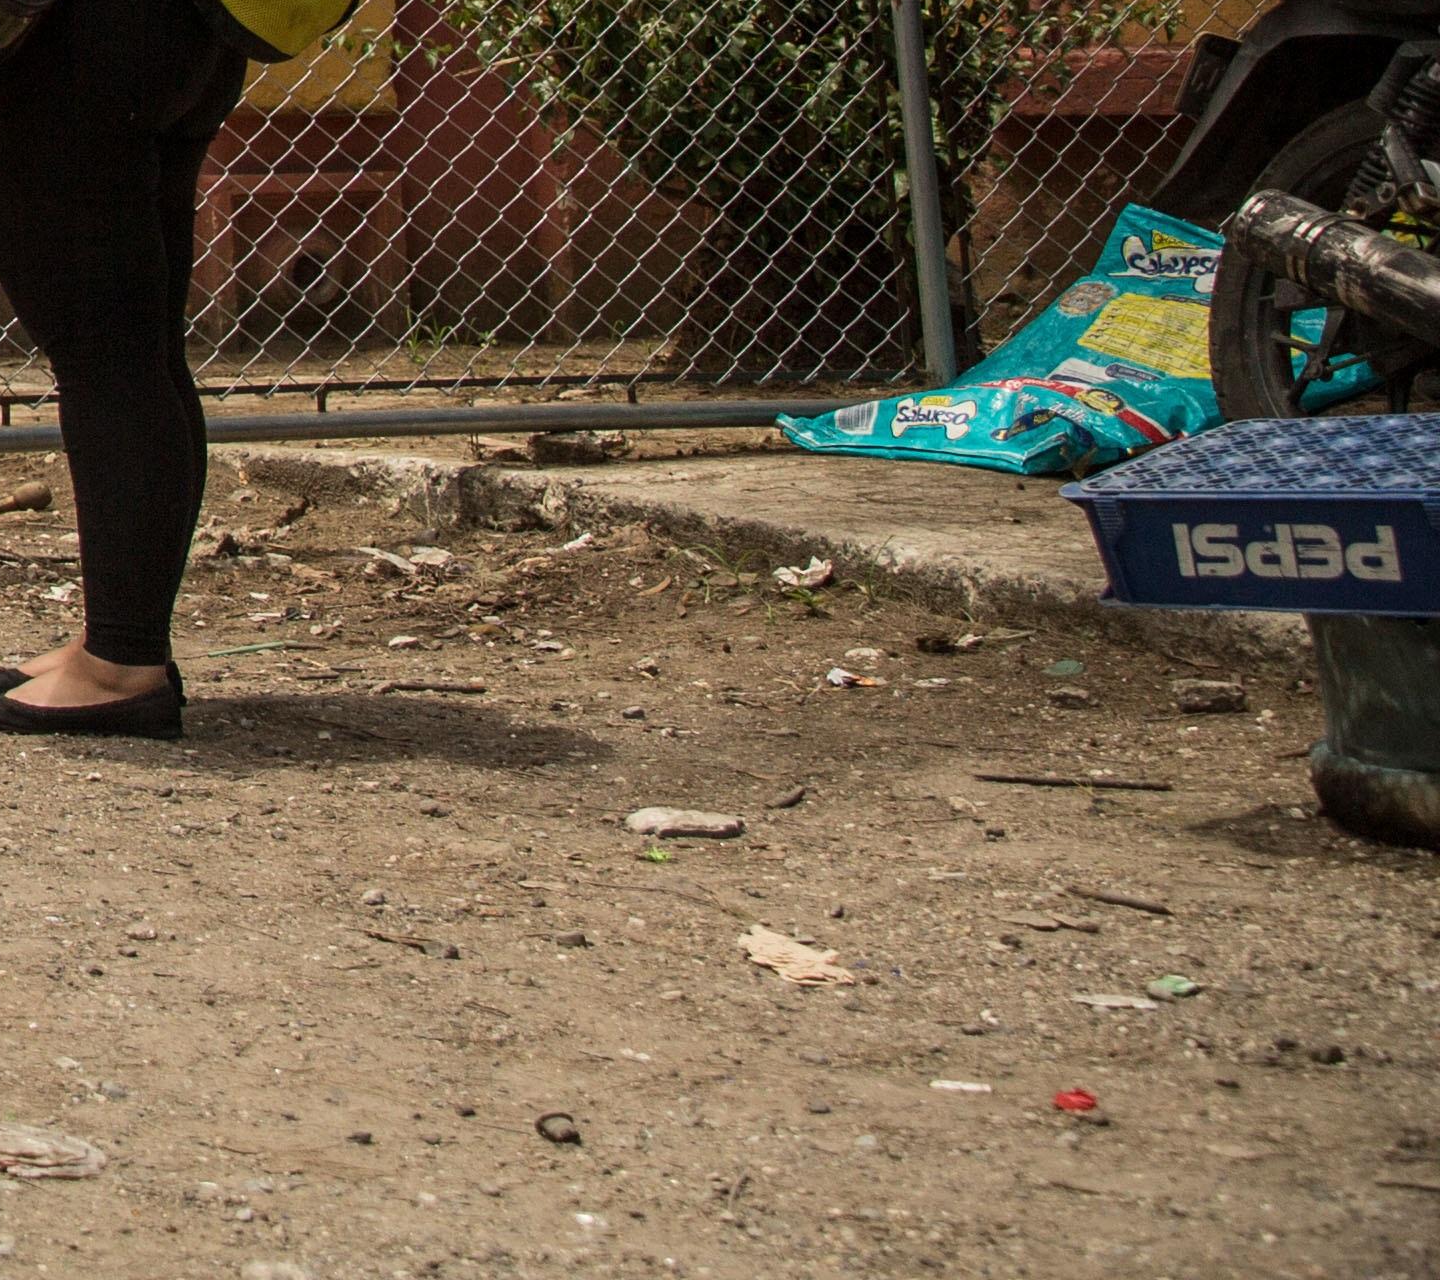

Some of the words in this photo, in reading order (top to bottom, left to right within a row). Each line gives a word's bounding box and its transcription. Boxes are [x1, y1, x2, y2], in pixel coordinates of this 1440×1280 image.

[1126, 251, 1218, 276] Sabues
[896, 404, 970, 424] Sabueso
[1173, 523, 1404, 584] PEPSI
